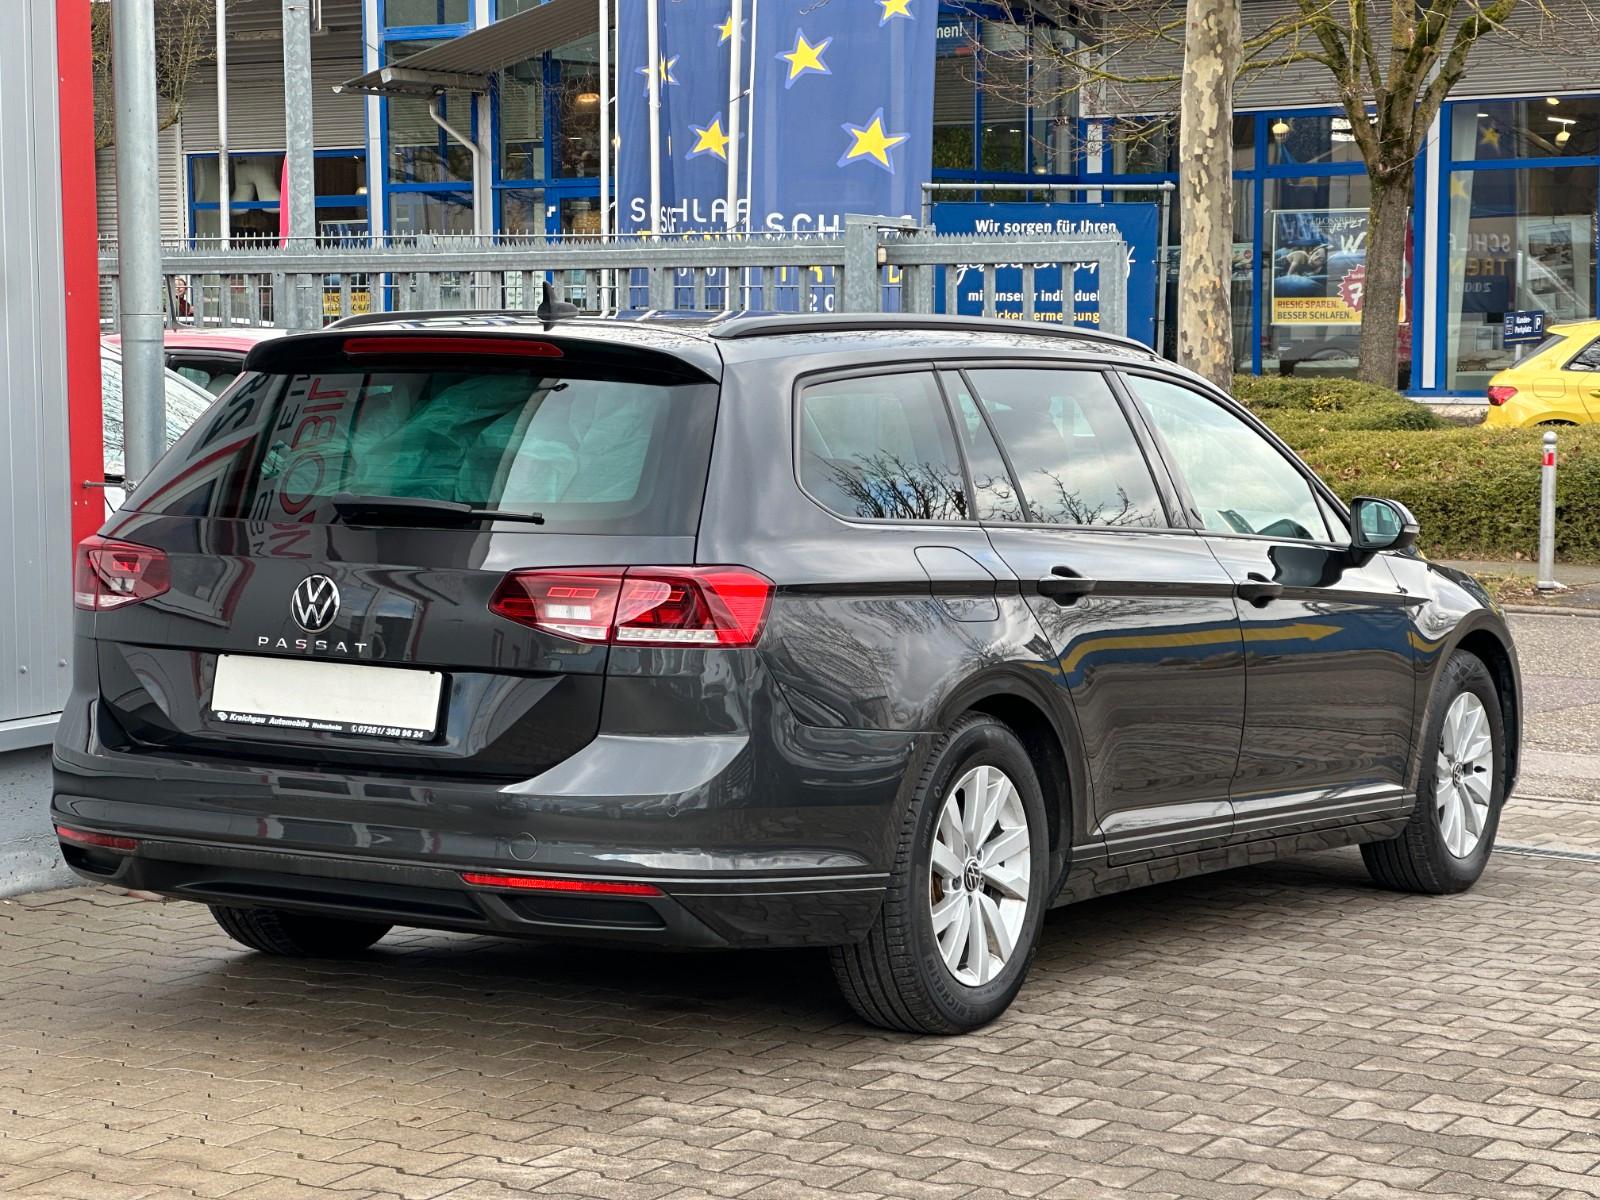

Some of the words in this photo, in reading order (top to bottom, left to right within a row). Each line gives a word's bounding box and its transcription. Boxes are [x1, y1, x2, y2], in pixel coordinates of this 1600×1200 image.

[975, 220, 1000, 232] Wir
[1003, 222, 1052, 235] sorgen
[1056, 220, 1076, 232] für
[1080, 220, 1117, 232] Ihren
[968, 290, 984, 302] mi
[1277, 301, 1304, 309] RIESIG
[1305, 300, 1340, 309] SPAREN.
[1277, 311, 1308, 319] BESSER
[1309, 311, 1353, 320] SCHLAFEN.
[258, 637, 368, 653] PASSAT
[269, 717, 310, 728] Automobile
[358, 726, 386, 735] 07251/
[386, 728, 401, 737] 358
[402, 729, 412, 737] 96
[413, 730, 424, 738] 24
